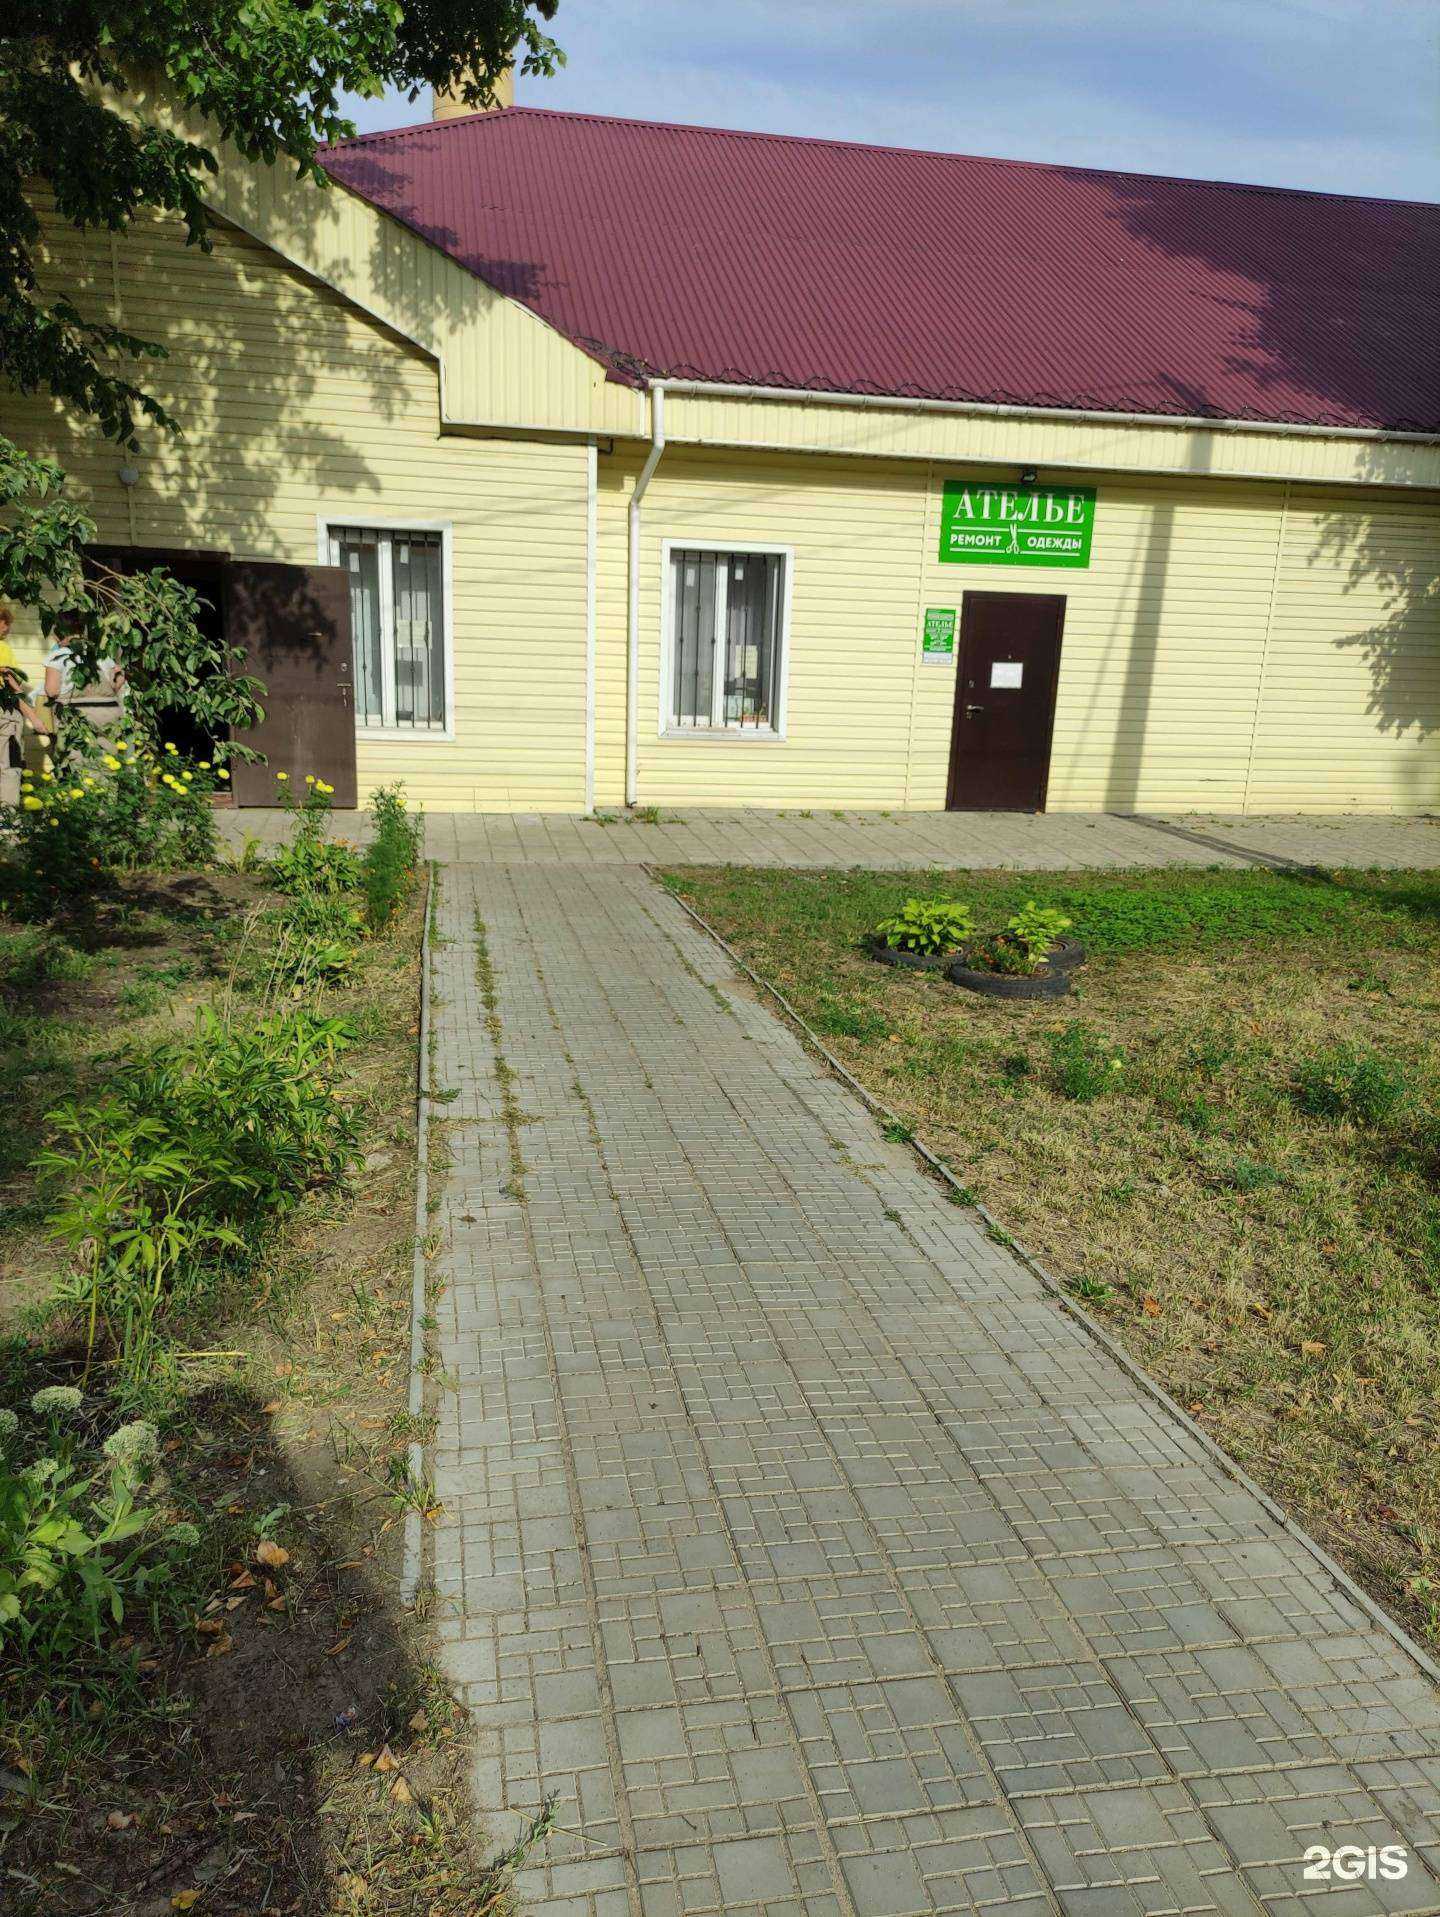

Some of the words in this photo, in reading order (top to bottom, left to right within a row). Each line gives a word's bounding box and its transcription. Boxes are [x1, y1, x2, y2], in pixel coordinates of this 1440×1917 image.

[953, 488, 1085, 524] АТЕЛЬЕ
[950, 533, 1002, 547] РЕМОНТ
[1027, 535, 1082, 550] ОДЕЖДЫ
